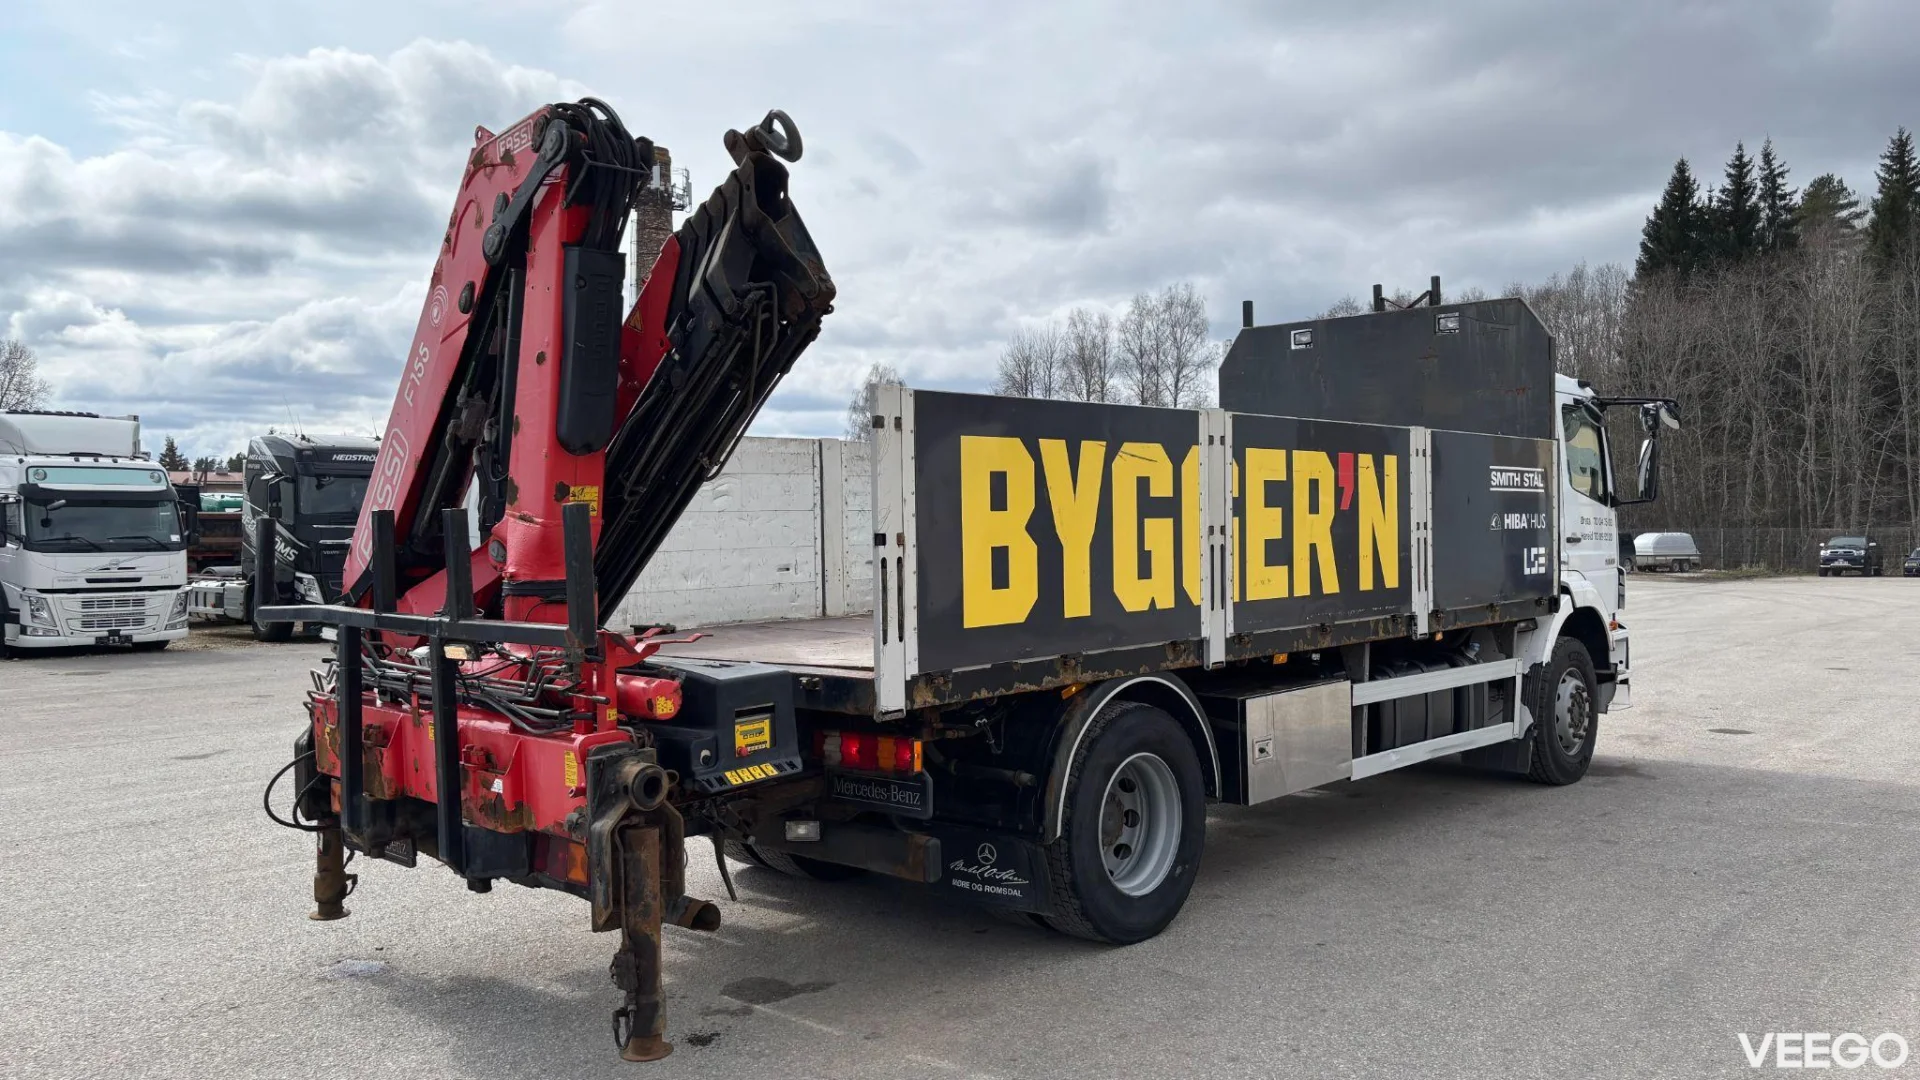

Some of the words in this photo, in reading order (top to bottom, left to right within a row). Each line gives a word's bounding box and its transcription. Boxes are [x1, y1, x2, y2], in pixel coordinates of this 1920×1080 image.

[500, 124, 532, 158] FASSI
[332, 453, 378, 462] HEDSTRÖ
[1490, 471, 1521, 487] SMITH
[361, 439, 405, 572] FSSI
[1530, 513, 1546, 529] HUS
[834, 776, 921, 805] Mercedes-Benz
[971, 882, 983, 892] OG
[984, 885, 1023, 897] ROMSDAL
